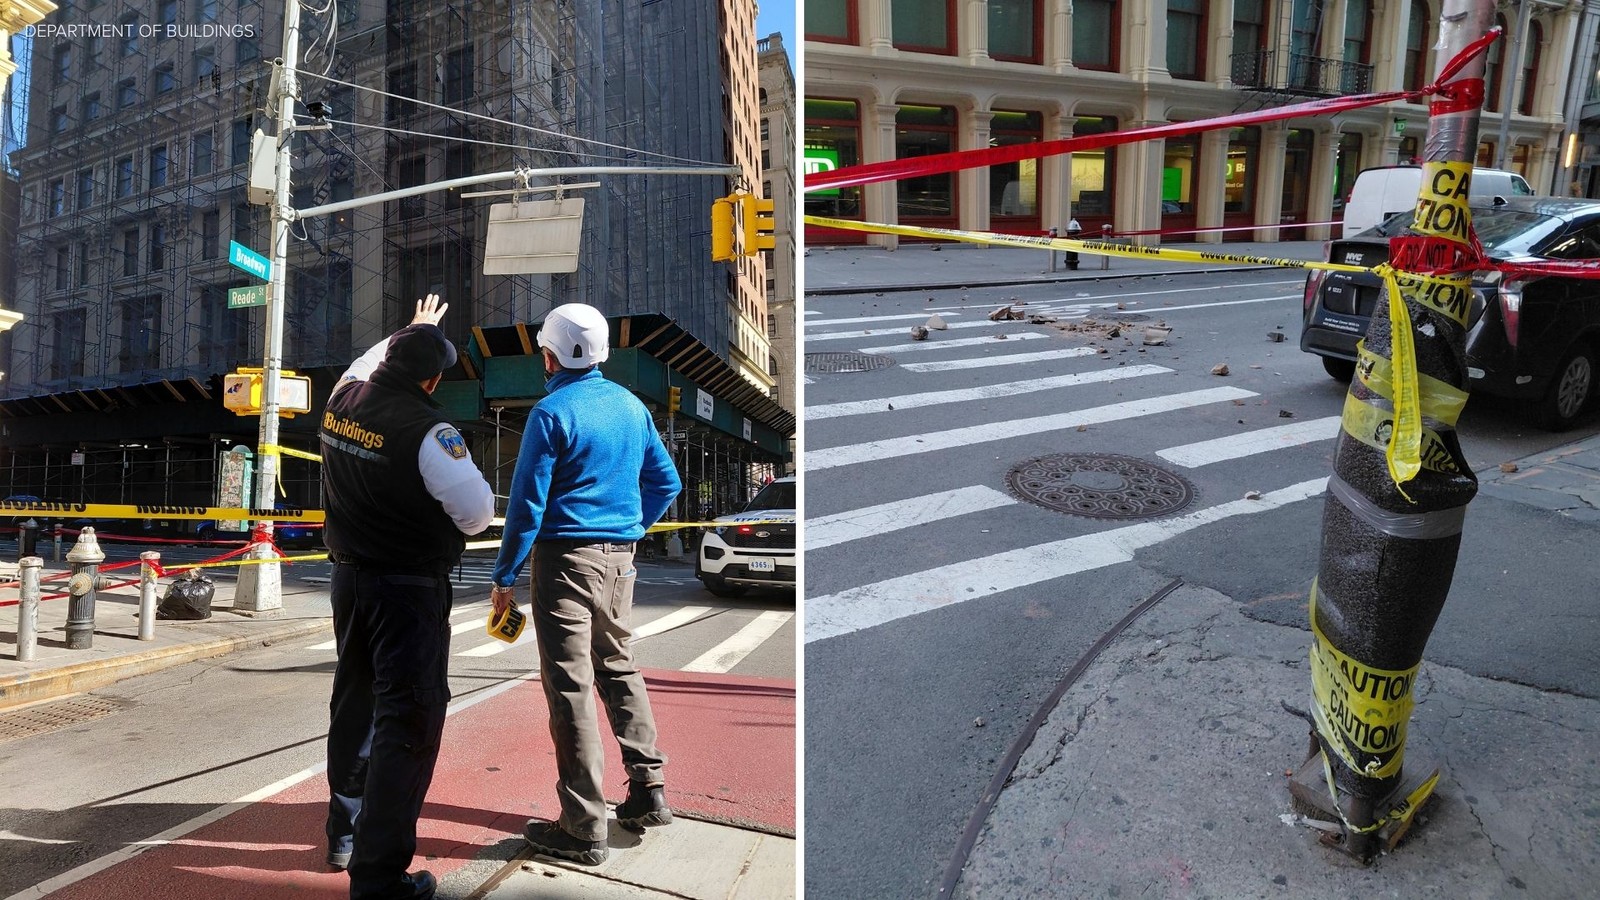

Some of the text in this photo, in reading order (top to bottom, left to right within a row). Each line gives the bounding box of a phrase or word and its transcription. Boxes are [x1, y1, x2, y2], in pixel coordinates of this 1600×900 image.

[236, 247, 266, 278] Broadway
[1346, 252, 1364, 261] NYC
[1426, 244, 1447, 268] NOT
[232, 287, 265, 306] Reade St
[750, 561, 767, 569] 4365
[1330, 689, 1400, 750] CAUTION
